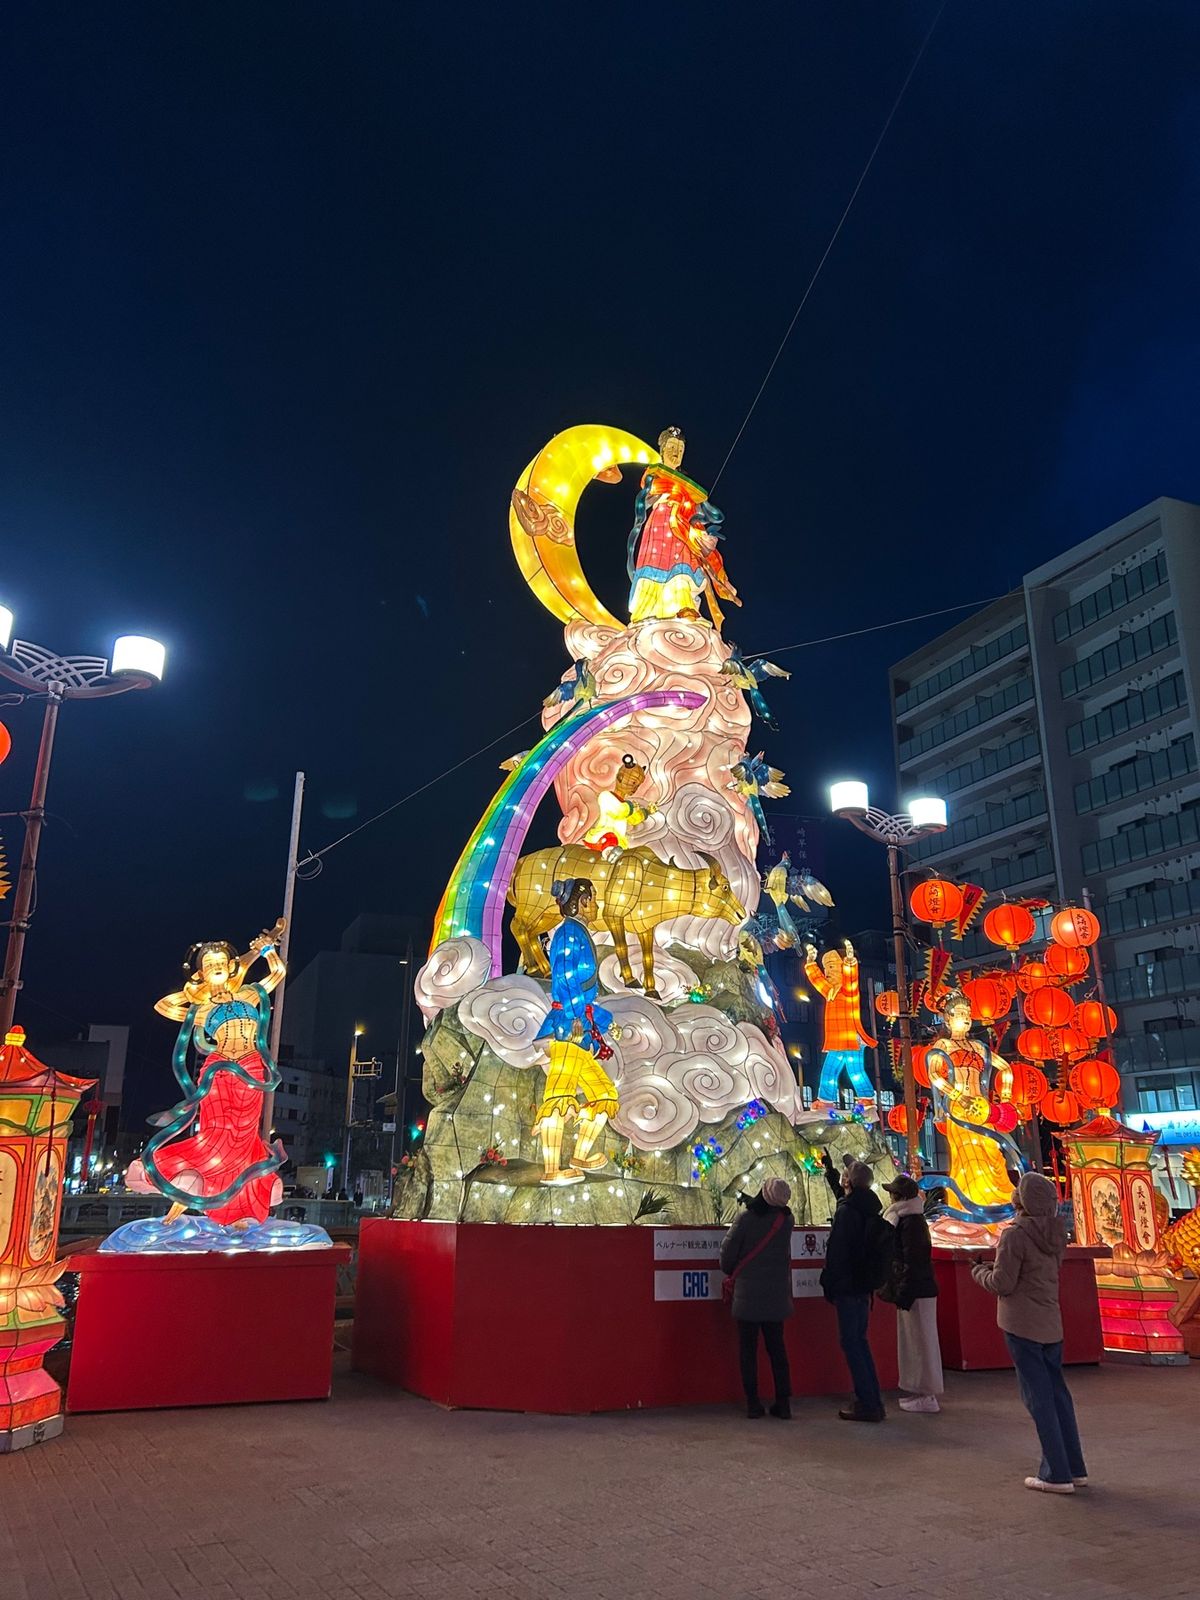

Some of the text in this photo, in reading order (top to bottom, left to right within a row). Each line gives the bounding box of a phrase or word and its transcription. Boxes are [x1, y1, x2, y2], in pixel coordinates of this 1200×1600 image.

[656, 1239, 722, 1250] ベルナード観光通り商
